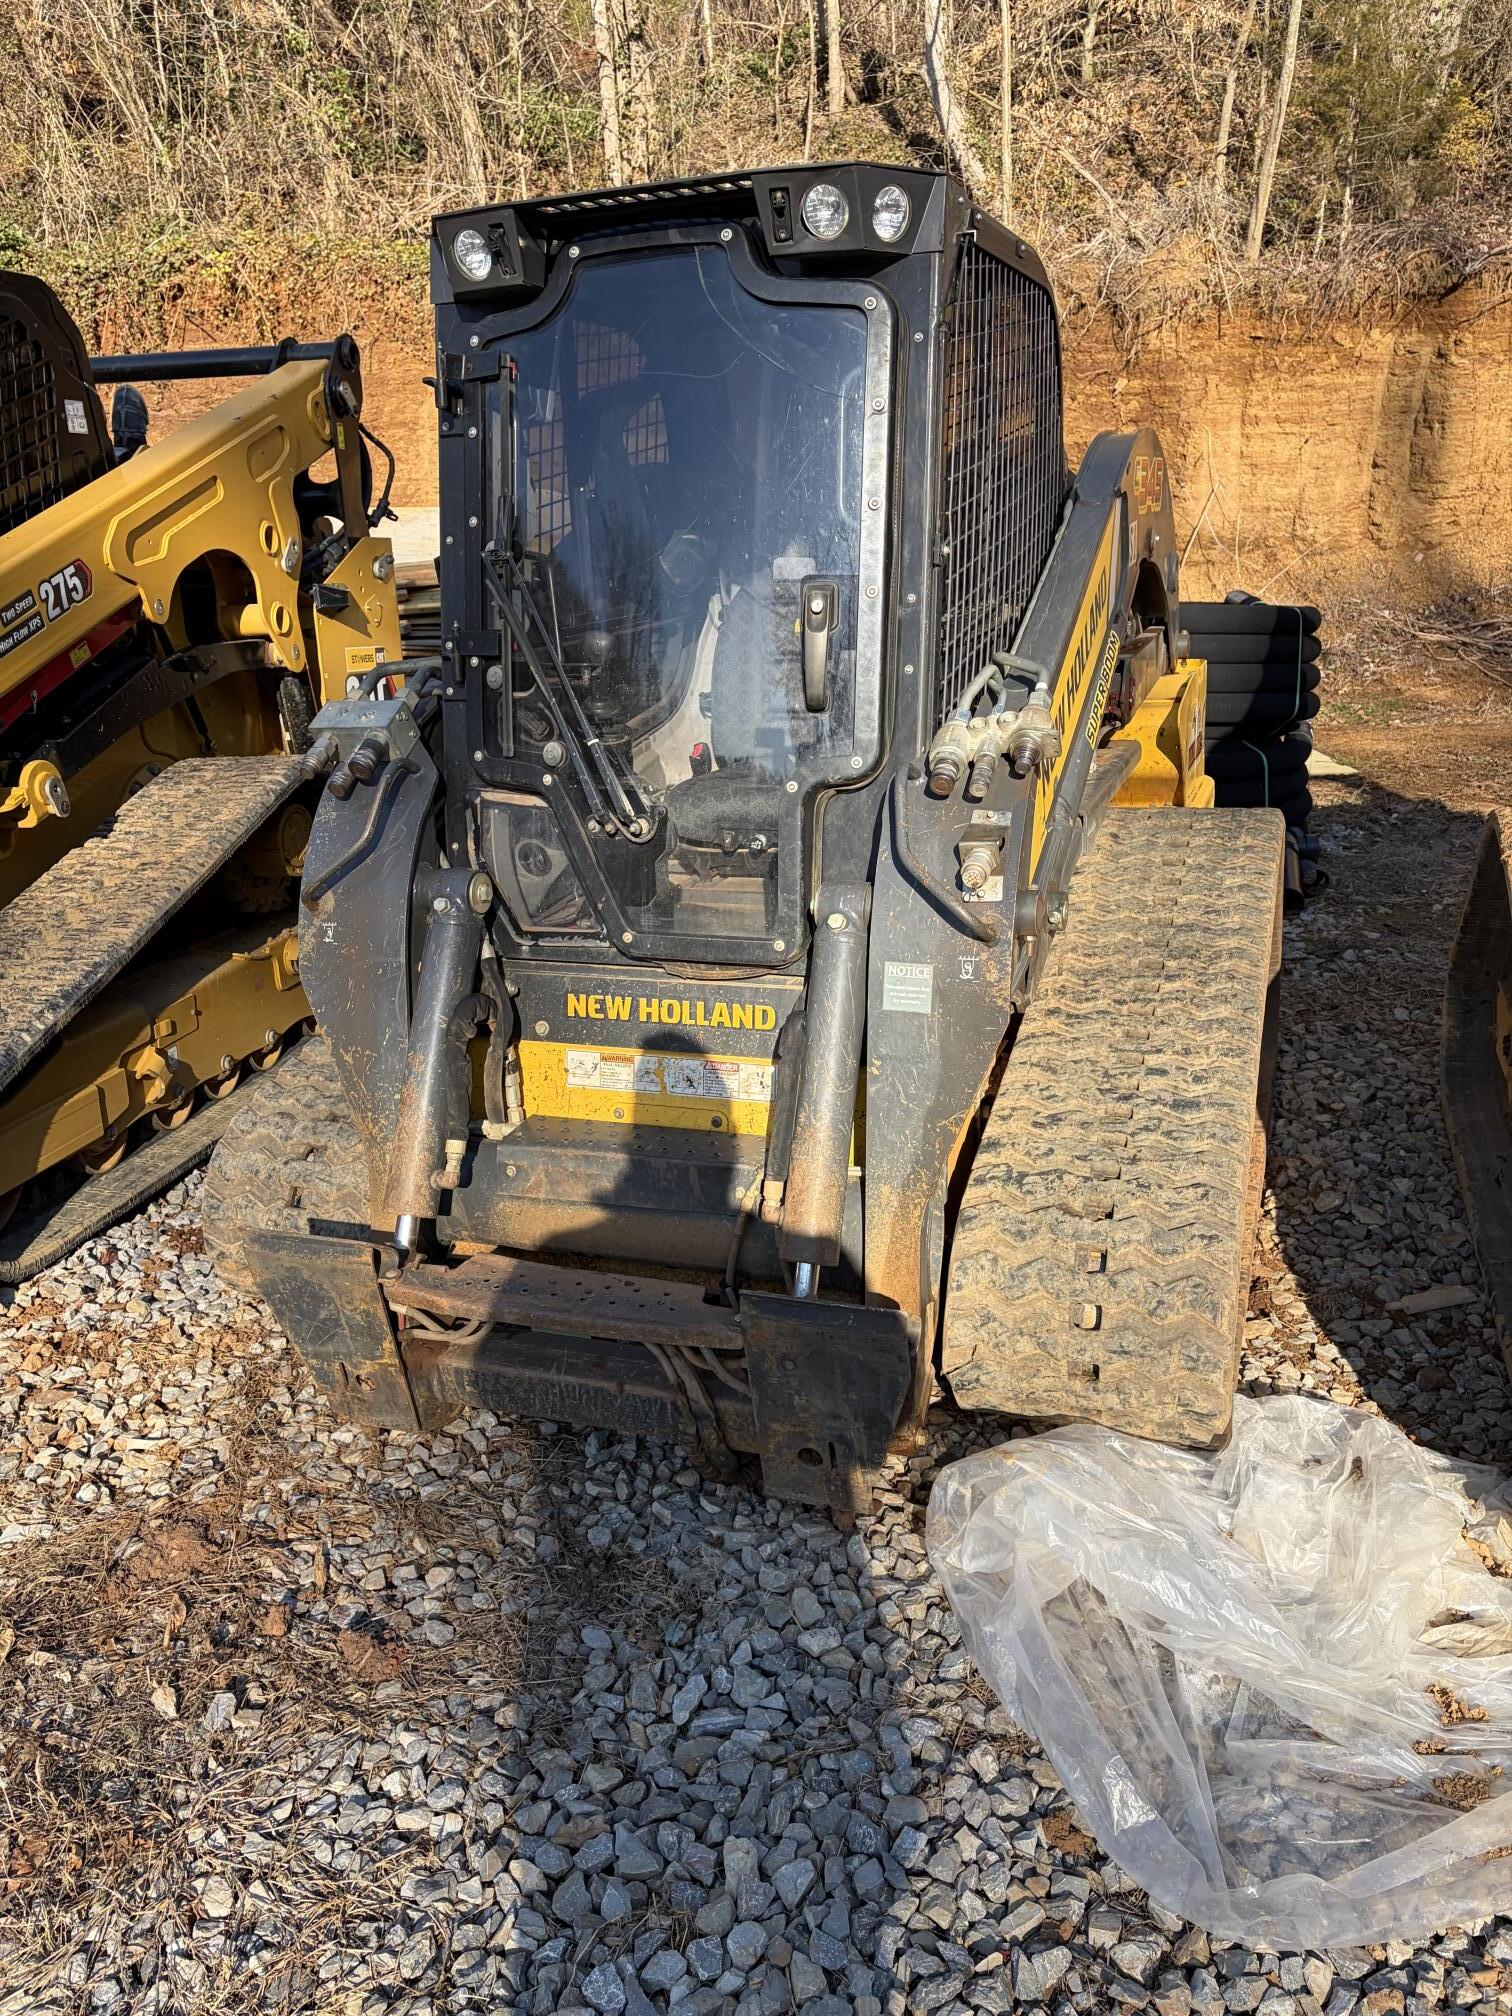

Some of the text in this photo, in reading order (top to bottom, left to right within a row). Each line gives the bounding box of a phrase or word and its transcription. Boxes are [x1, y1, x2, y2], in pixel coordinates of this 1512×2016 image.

[40, 564, 84, 620] 275
[28, 615, 42, 632] XPS
[1067, 566, 1108, 718] HOLLAND
[888, 965, 930, 978] NOTICE
[567, 993, 776, 1031] NEW HOLLAND
[606, 1054, 634, 1063] WARNING
